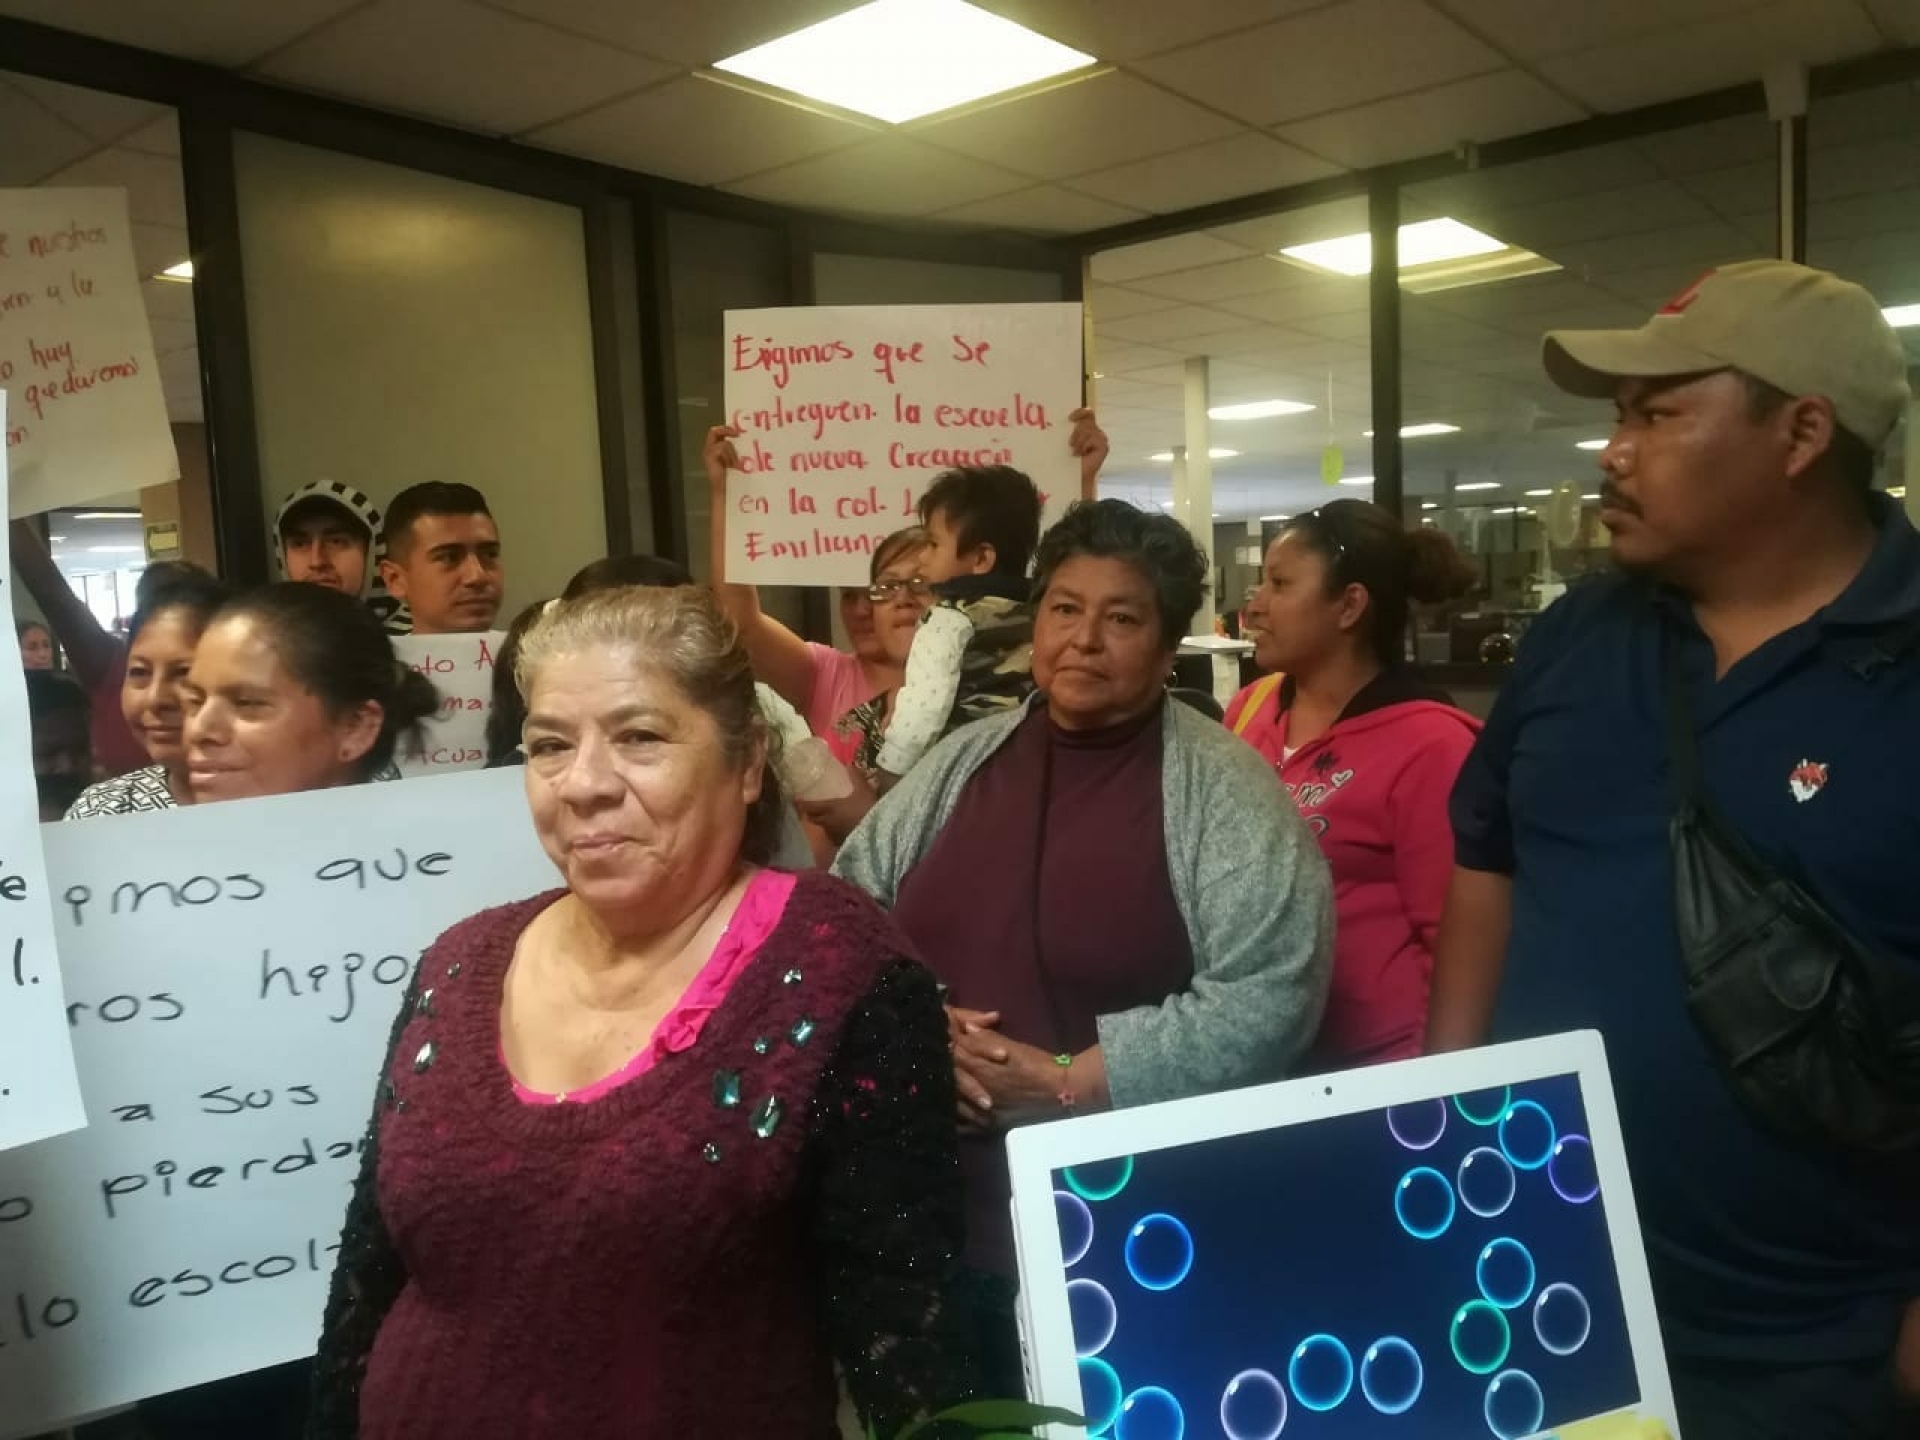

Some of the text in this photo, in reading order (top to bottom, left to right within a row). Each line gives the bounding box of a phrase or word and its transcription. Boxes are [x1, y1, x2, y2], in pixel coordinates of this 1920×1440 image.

[873, 342, 923, 384] que
[895, 392, 921, 424] la
[789, 487, 816, 515] la
